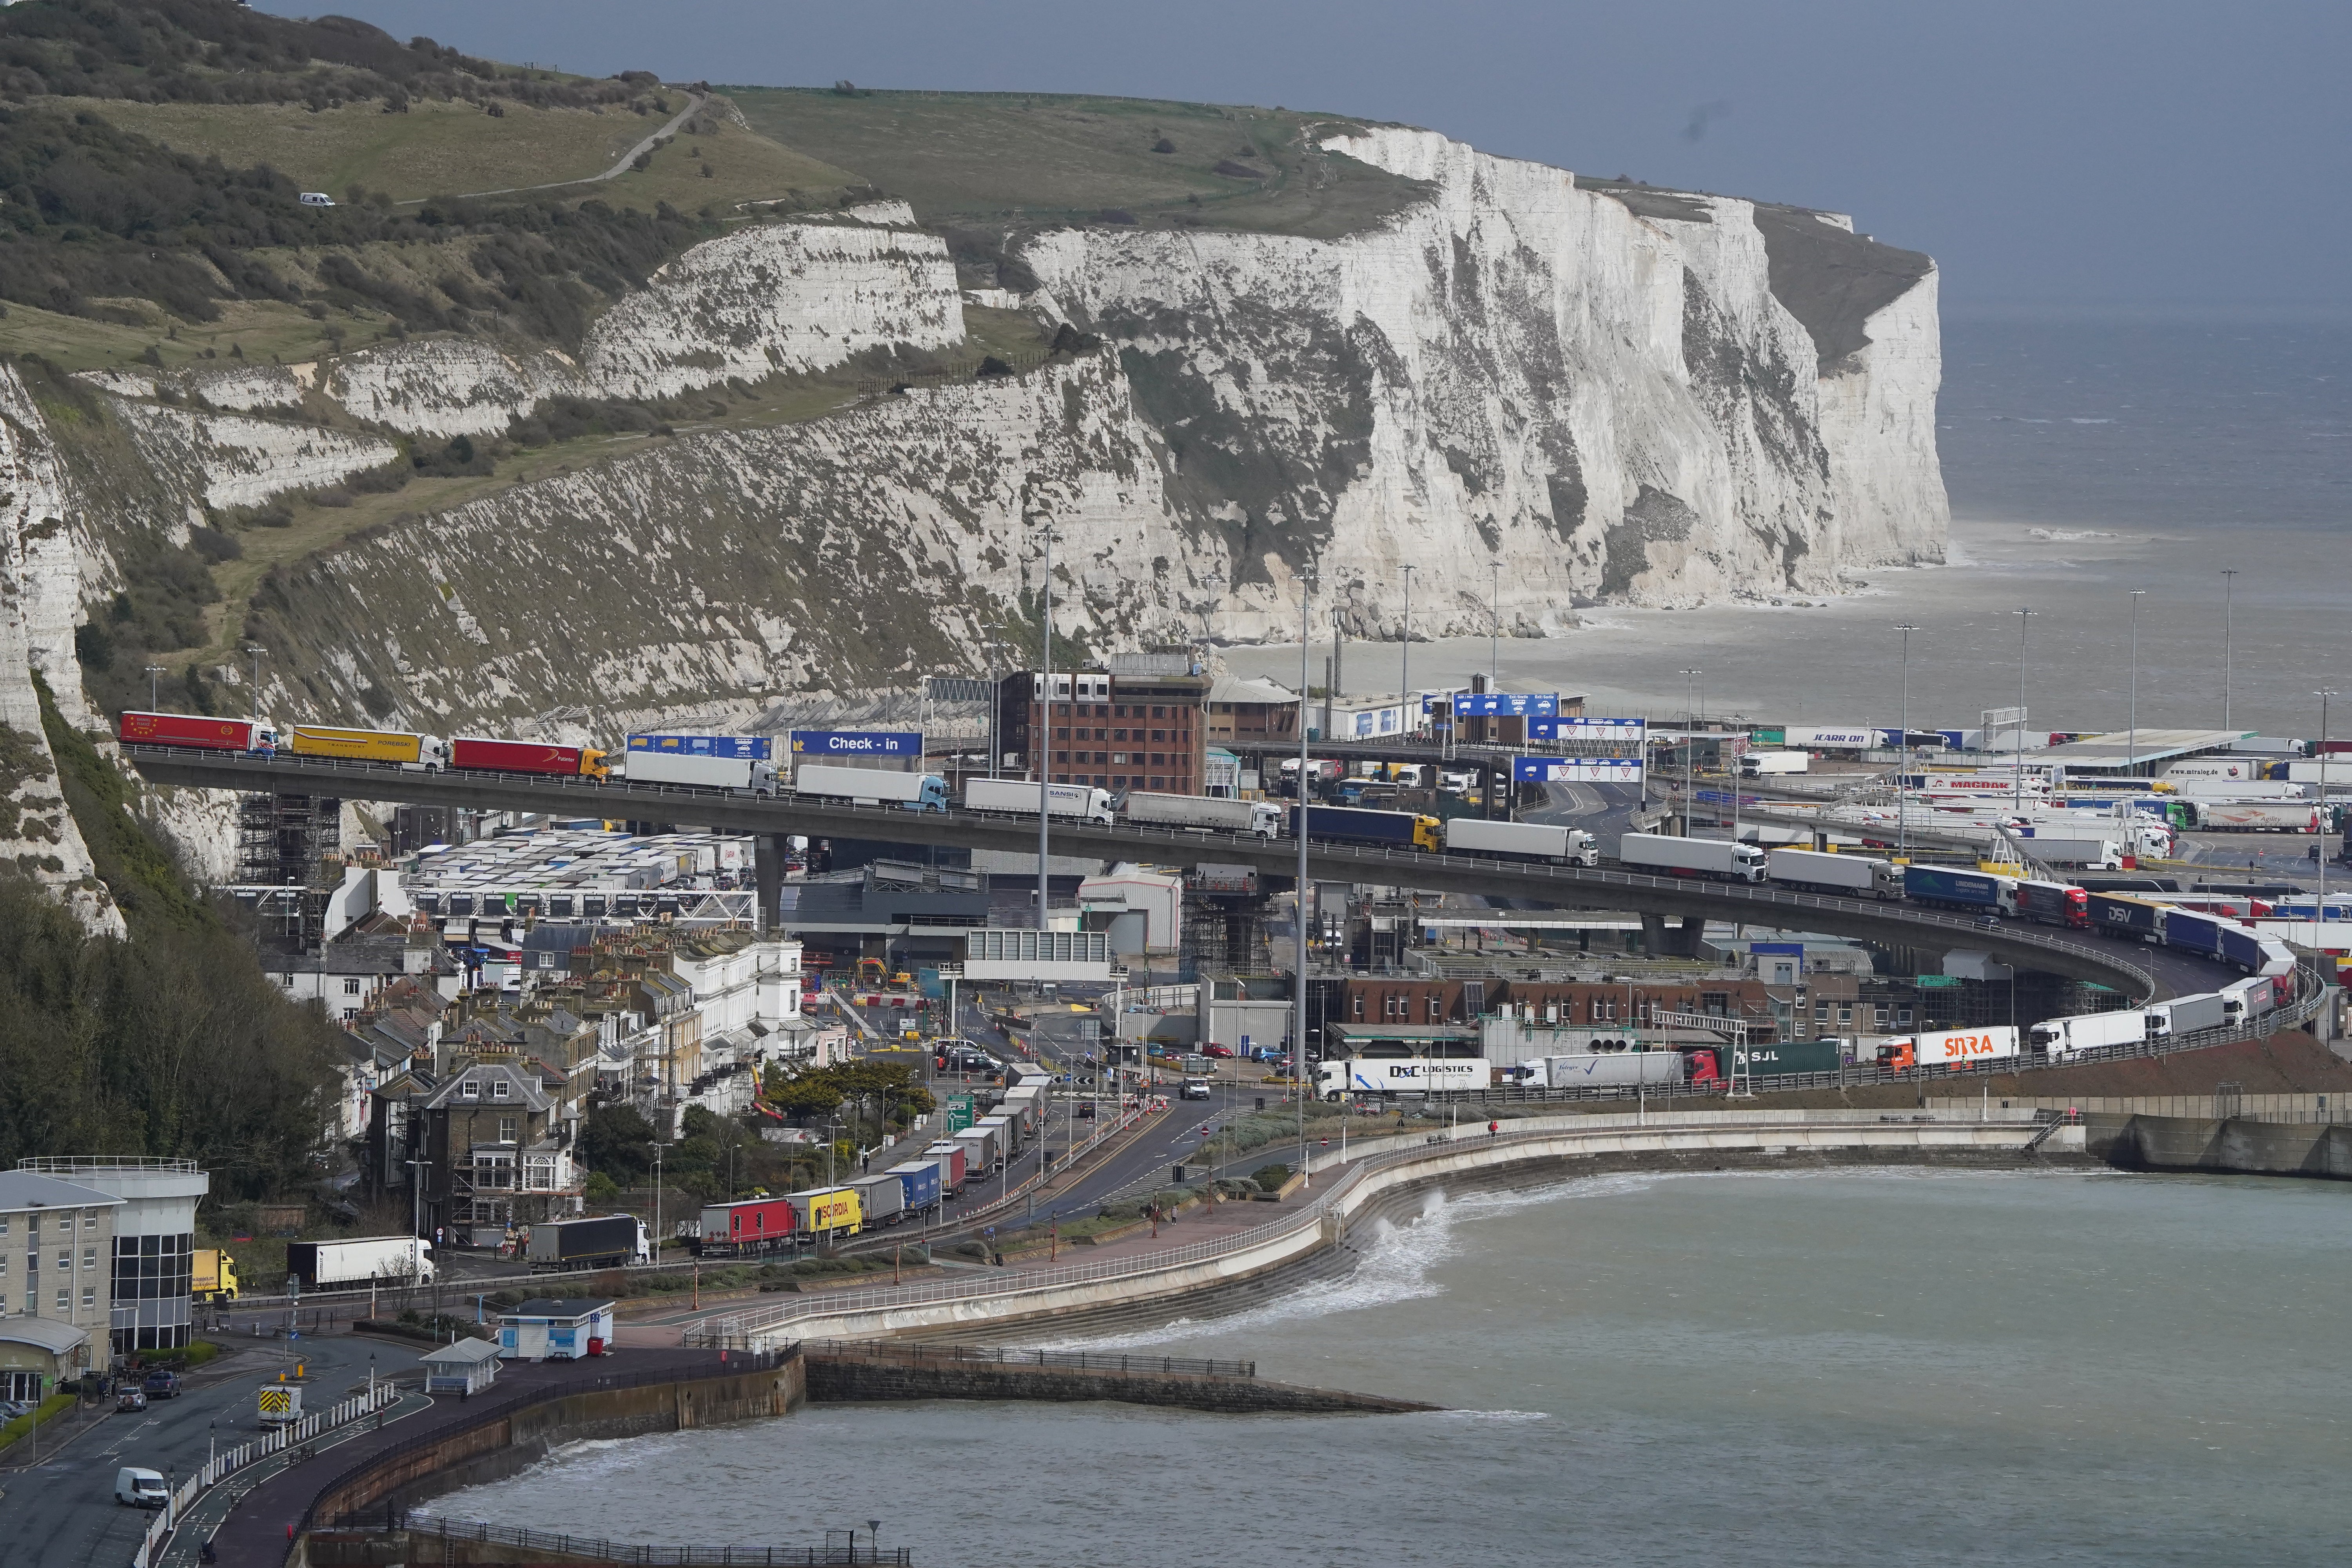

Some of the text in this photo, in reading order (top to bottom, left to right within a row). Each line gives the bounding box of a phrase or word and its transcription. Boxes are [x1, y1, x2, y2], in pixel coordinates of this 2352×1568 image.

[829, 737, 873, 749] Check
[886, 738, 898, 750] in
[1950, 780, 2011, 789] MAGDAK
[1955, 880, 1989, 889] LINDEMANN
[2109, 906, 2132, 923] DSV
[1751, 1051, 1779, 1062] SJL
[1390, 1066, 1420, 1078] D&C
